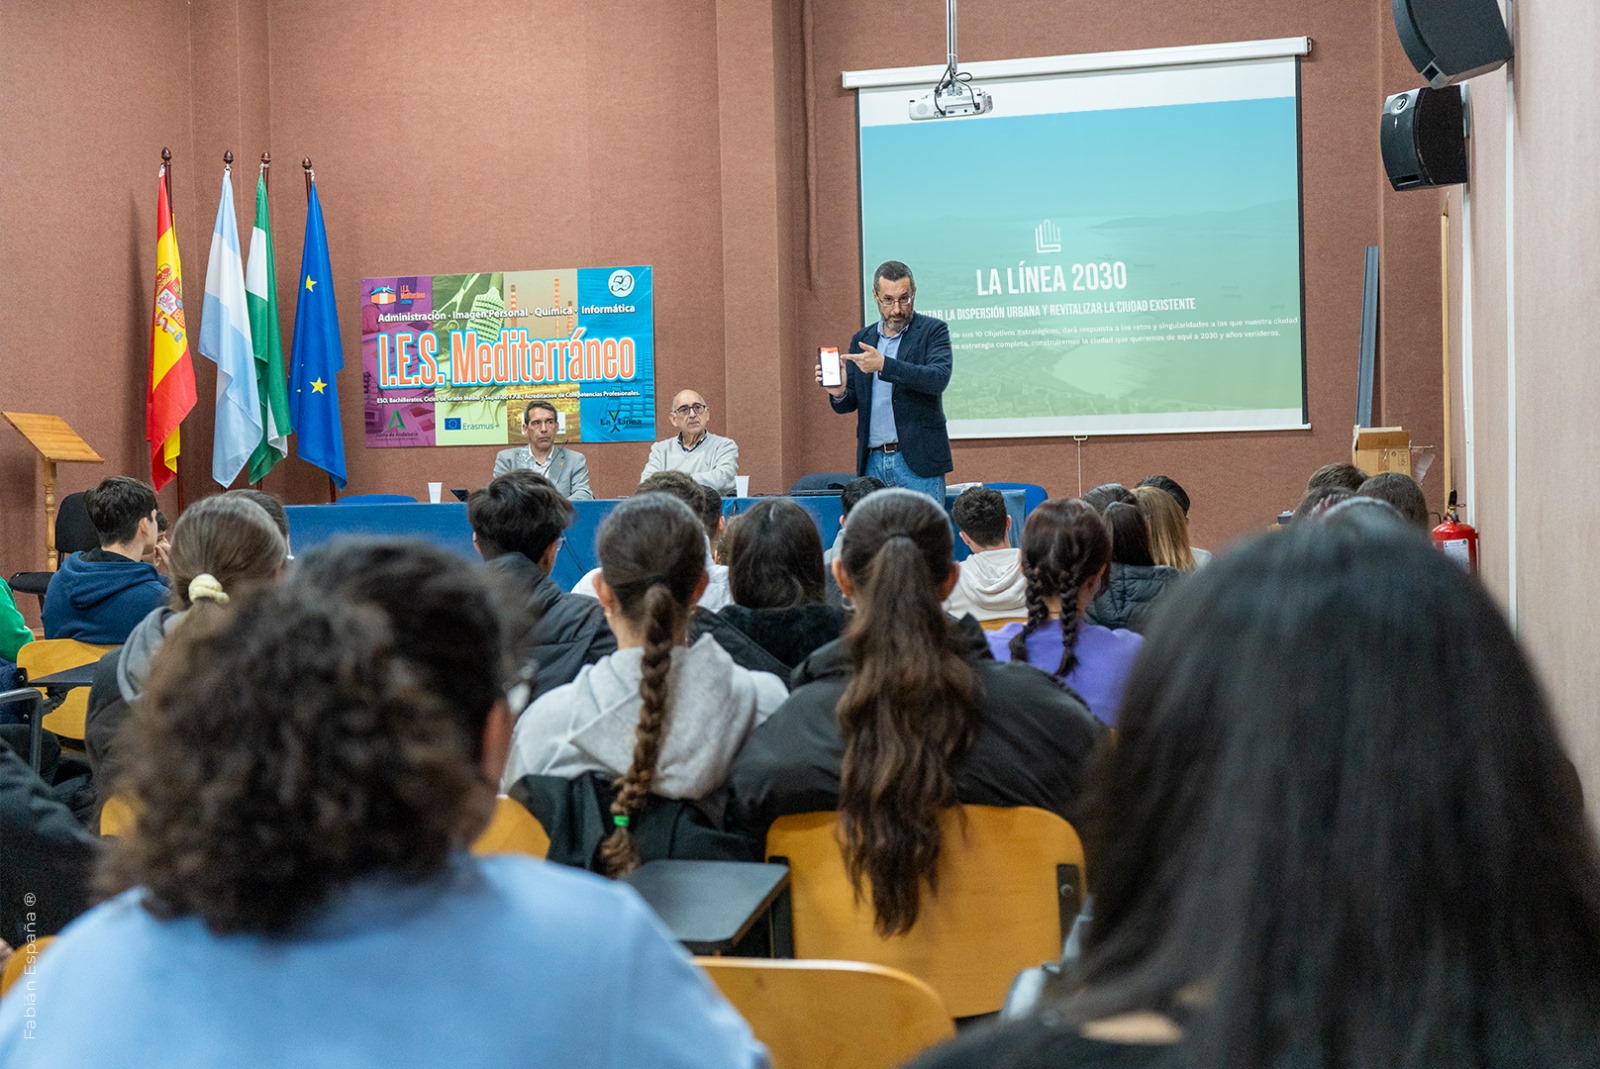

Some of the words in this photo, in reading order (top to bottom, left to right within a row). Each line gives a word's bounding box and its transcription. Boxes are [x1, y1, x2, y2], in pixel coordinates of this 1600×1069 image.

[976, 268, 1002, 296] LA
[1007, 260, 1067, 295] LÍNEA
[1071, 261, 1127, 292] 2030
[378, 311, 447, 322] Administración
[452, 311, 487, 321] Imagen
[488, 308, 528, 319] Personal
[534, 306, 573, 316] Química
[581, 303, 635, 315] Informática
[945, 309, 956, 320] LA
[957, 304, 1005, 320] DISPERSIÓN
[1007, 304, 1041, 318] URBANA
[1042, 304, 1048, 316] Y
[1050, 301, 1102, 316] REVITALIZAR
[1104, 301, 1116, 313] LA
[1117, 300, 1149, 313] CIUDAD
[1150, 297, 1197, 311] EXISTENTE
[975, 330, 983, 338] 10
[984, 330, 1015, 339] Objetivos
[1079, 326, 1114, 335] respuesta
[1121, 323, 1132, 332] los
[1158, 321, 1208, 331] singularidades
[1217, 319, 1228, 327] las
[1229, 320, 1243, 329] que
[1245, 319, 1272, 327] nuestra
[1273, 316, 1298, 325] ciudad
[996, 338, 1030, 349] completa,
[1031, 337, 1081, 347] construiremos
[1090, 335, 1114, 345] ciudad
[1115, 335, 1129, 345] que
[1130, 334, 1165, 345] queremos
[1166, 332, 1176, 341] de
[1200, 331, 1219, 340] 2030
[1220, 332, 1224, 341] y
[1225, 330, 1243, 339] años
[1244, 329, 1281, 338] venideros.
[378, 331, 445, 387] I.E.S.
[450, 327, 635, 384] Mediterráneo
